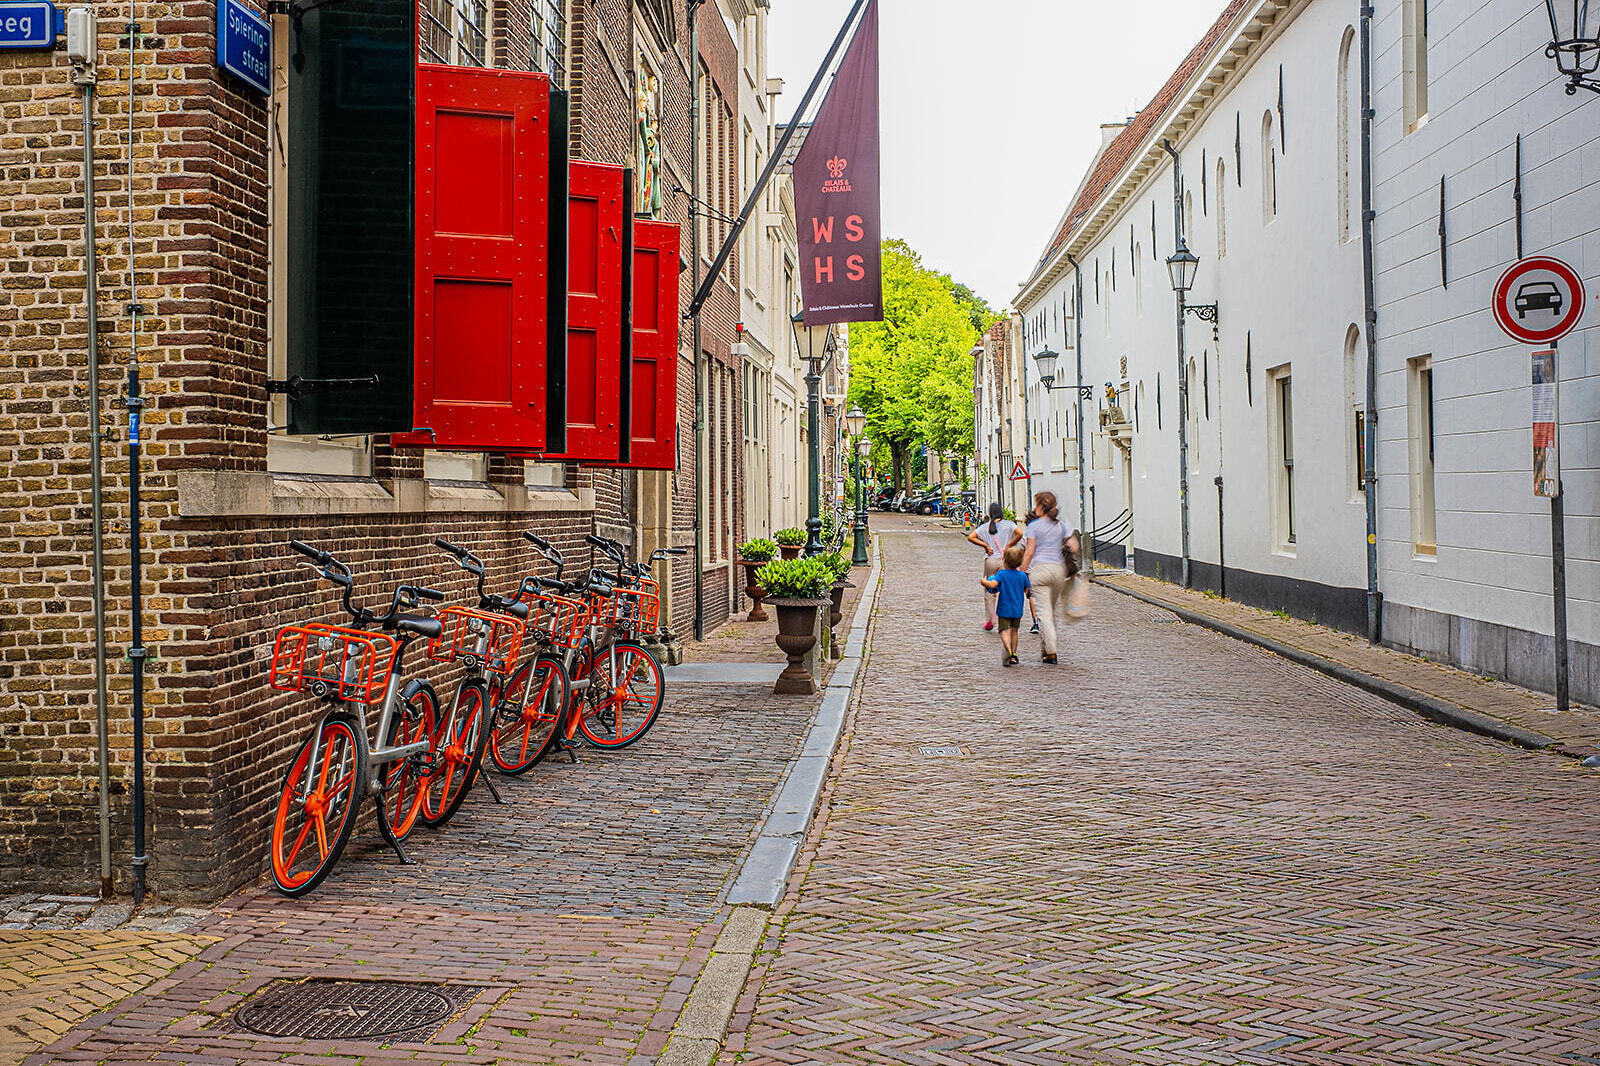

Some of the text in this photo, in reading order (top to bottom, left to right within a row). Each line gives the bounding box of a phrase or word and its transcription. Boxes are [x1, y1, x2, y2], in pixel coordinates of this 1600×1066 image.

[0, 17, 31, 39] eg
[229, 8, 268, 55] Spiering-
[242, 49, 268, 80] straat
